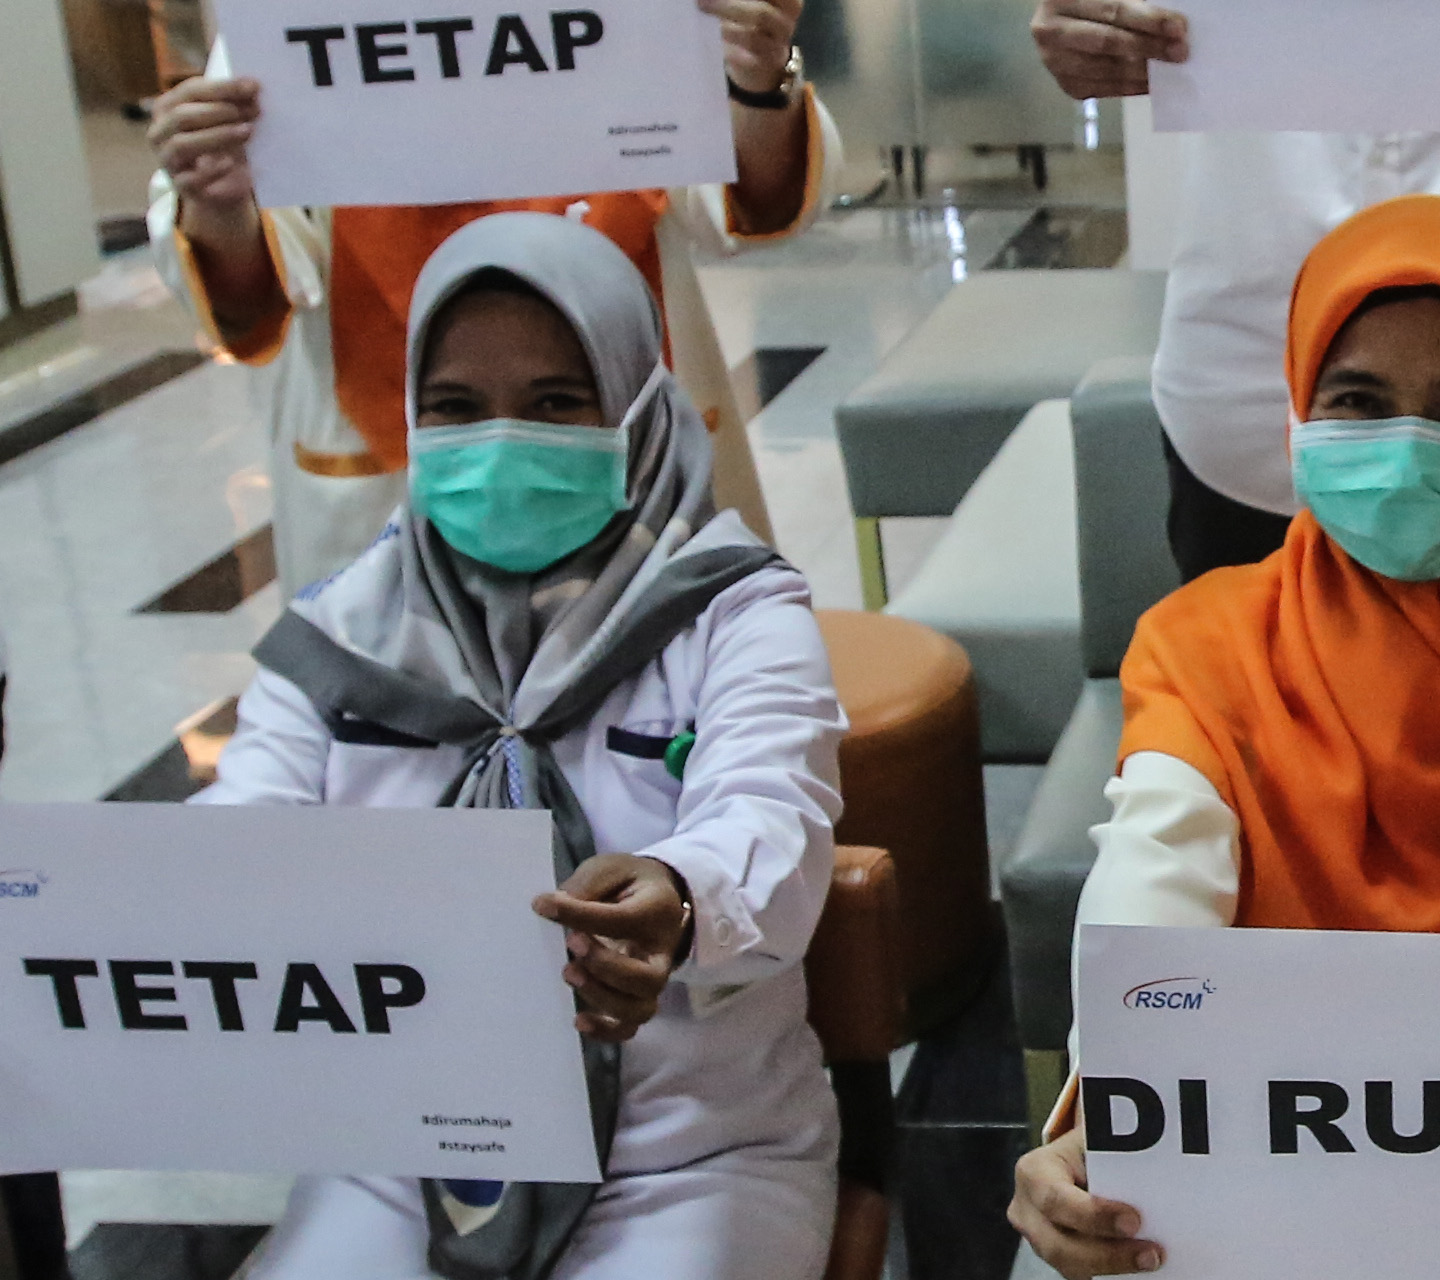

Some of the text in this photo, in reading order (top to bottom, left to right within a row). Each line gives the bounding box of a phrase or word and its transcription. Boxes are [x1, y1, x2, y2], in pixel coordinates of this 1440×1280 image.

[285, 10, 603, 87] TETAP
[23, 958, 426, 1034] TETAP
[1135, 991, 1203, 1010] RSCM
[422, 1115, 511, 1129] #dirumahaja
[1082, 1076, 1210, 1155] DI
[439, 1141, 505, 1153] #staysafe
